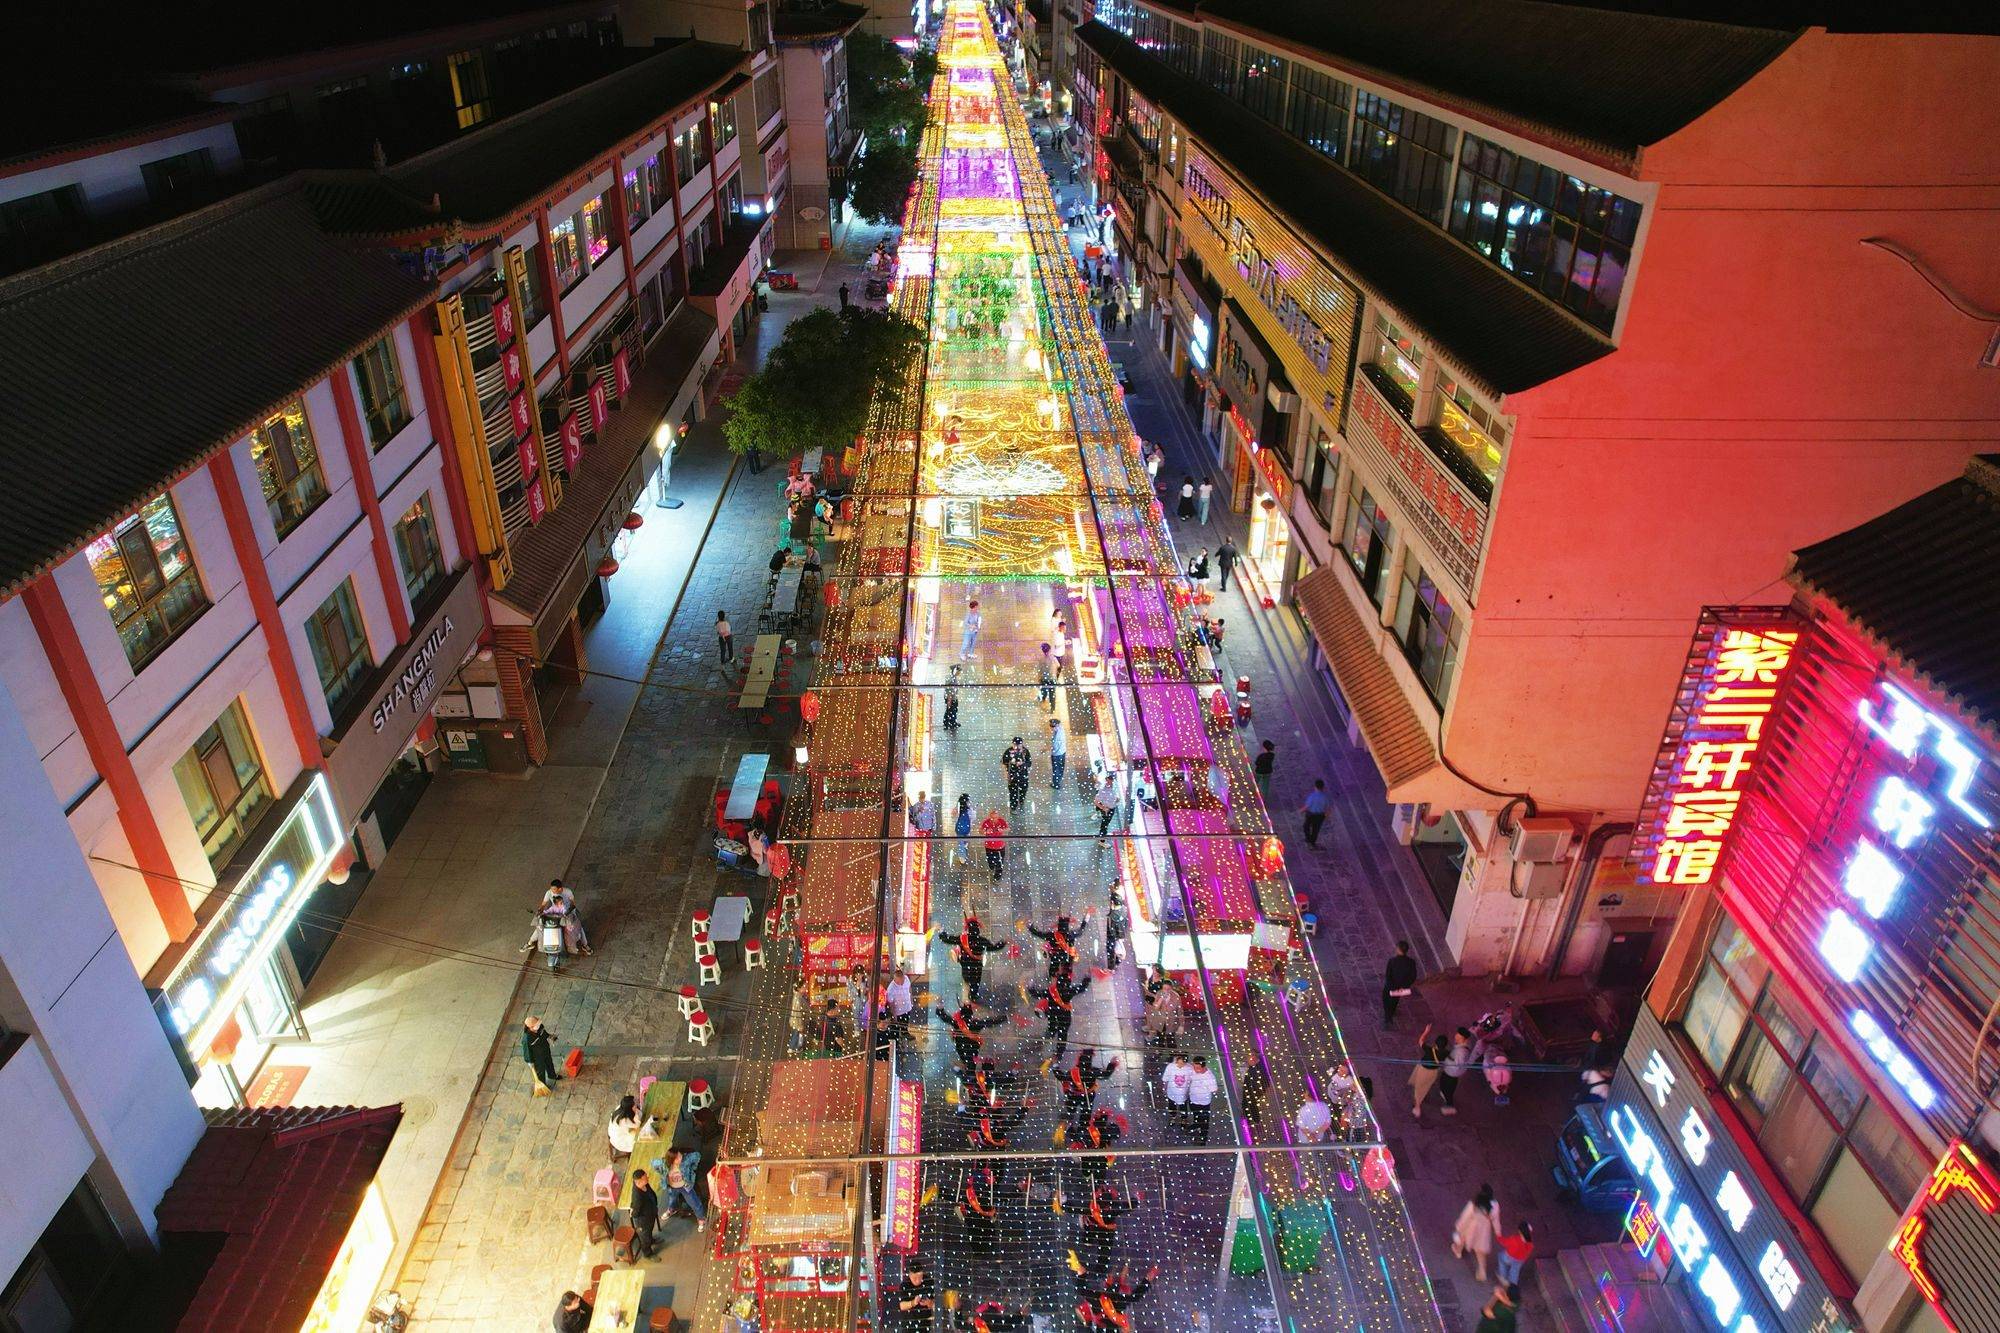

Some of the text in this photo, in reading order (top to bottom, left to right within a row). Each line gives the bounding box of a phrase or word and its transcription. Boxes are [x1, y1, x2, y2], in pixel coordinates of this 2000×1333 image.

[372, 616, 455, 734] SHANGMILA
[1653, 630, 1798, 885] 紫气轩宾馆
